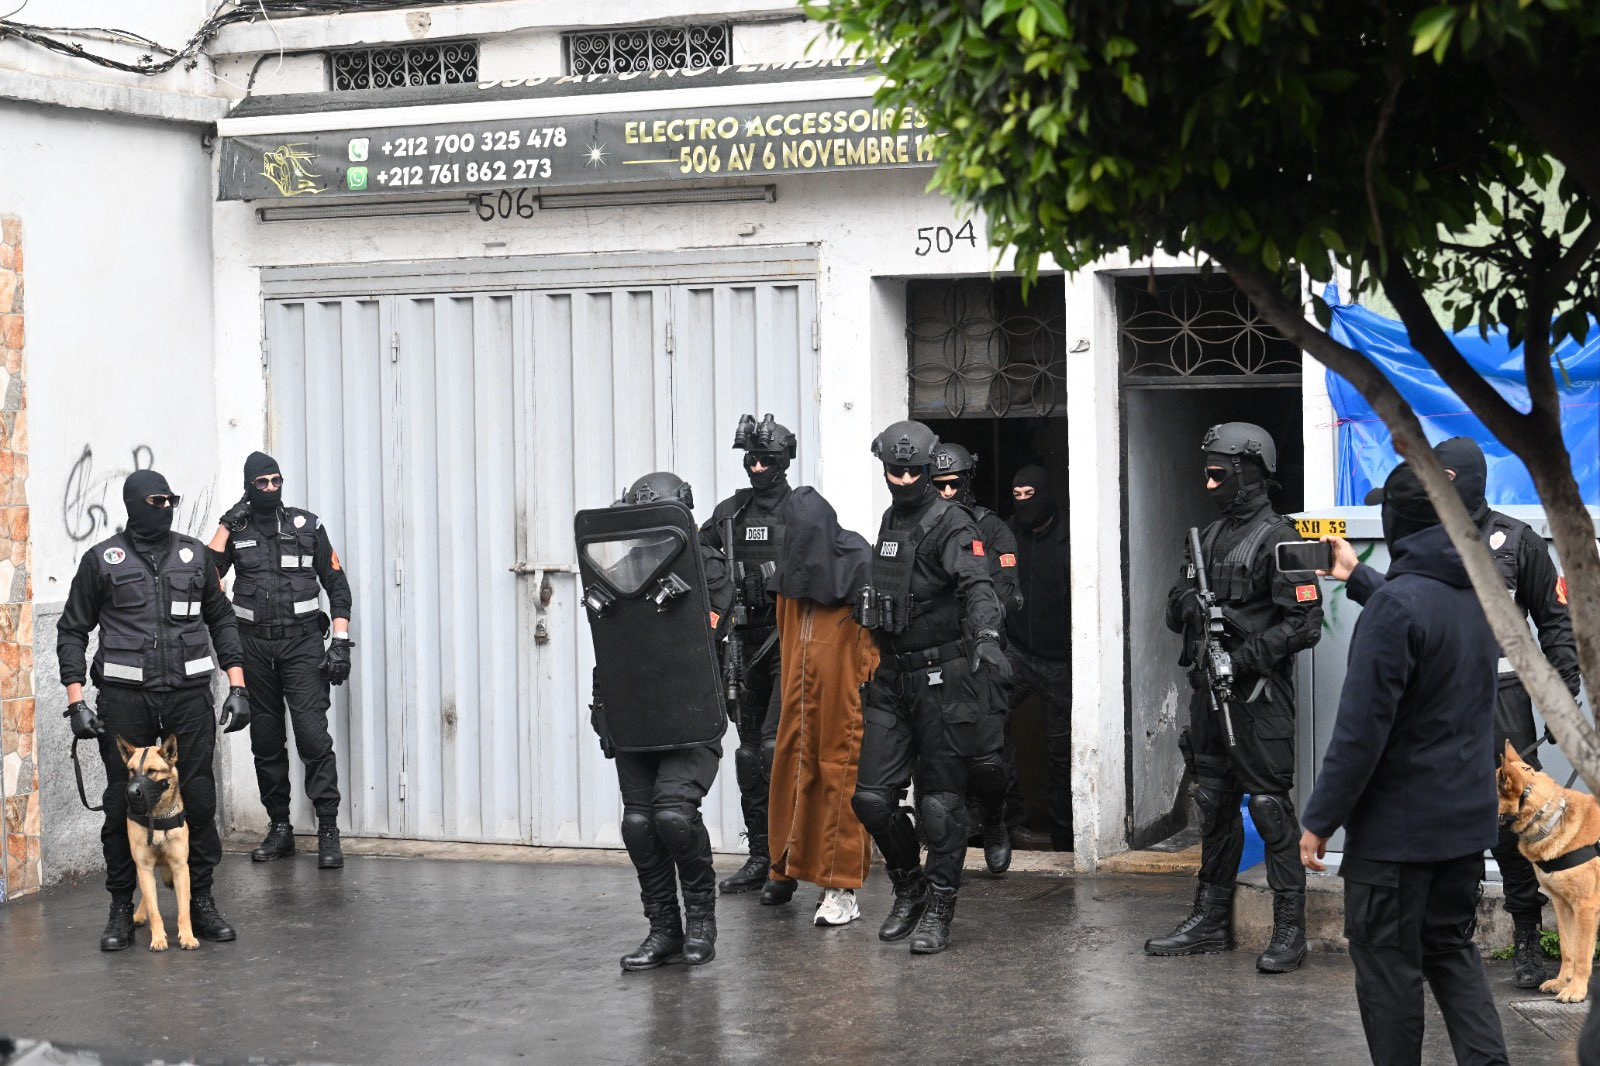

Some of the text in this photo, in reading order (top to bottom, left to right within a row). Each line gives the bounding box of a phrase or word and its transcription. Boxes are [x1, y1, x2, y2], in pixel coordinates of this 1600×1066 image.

[625, 106, 929, 144] ELECTRO ACCESSOIRES
[381, 127, 567, 157] +212 700 325 478
[679, 145, 721, 174] 506
[727, 143, 756, 171] AV
[762, 142, 776, 170] 6
[782, 135, 909, 169] NOVEMBRE
[376, 158, 552, 186] +212 761 862 273
[476, 188, 534, 221] 506
[915, 219, 977, 256] 504
[748, 528, 765, 540] DGST
